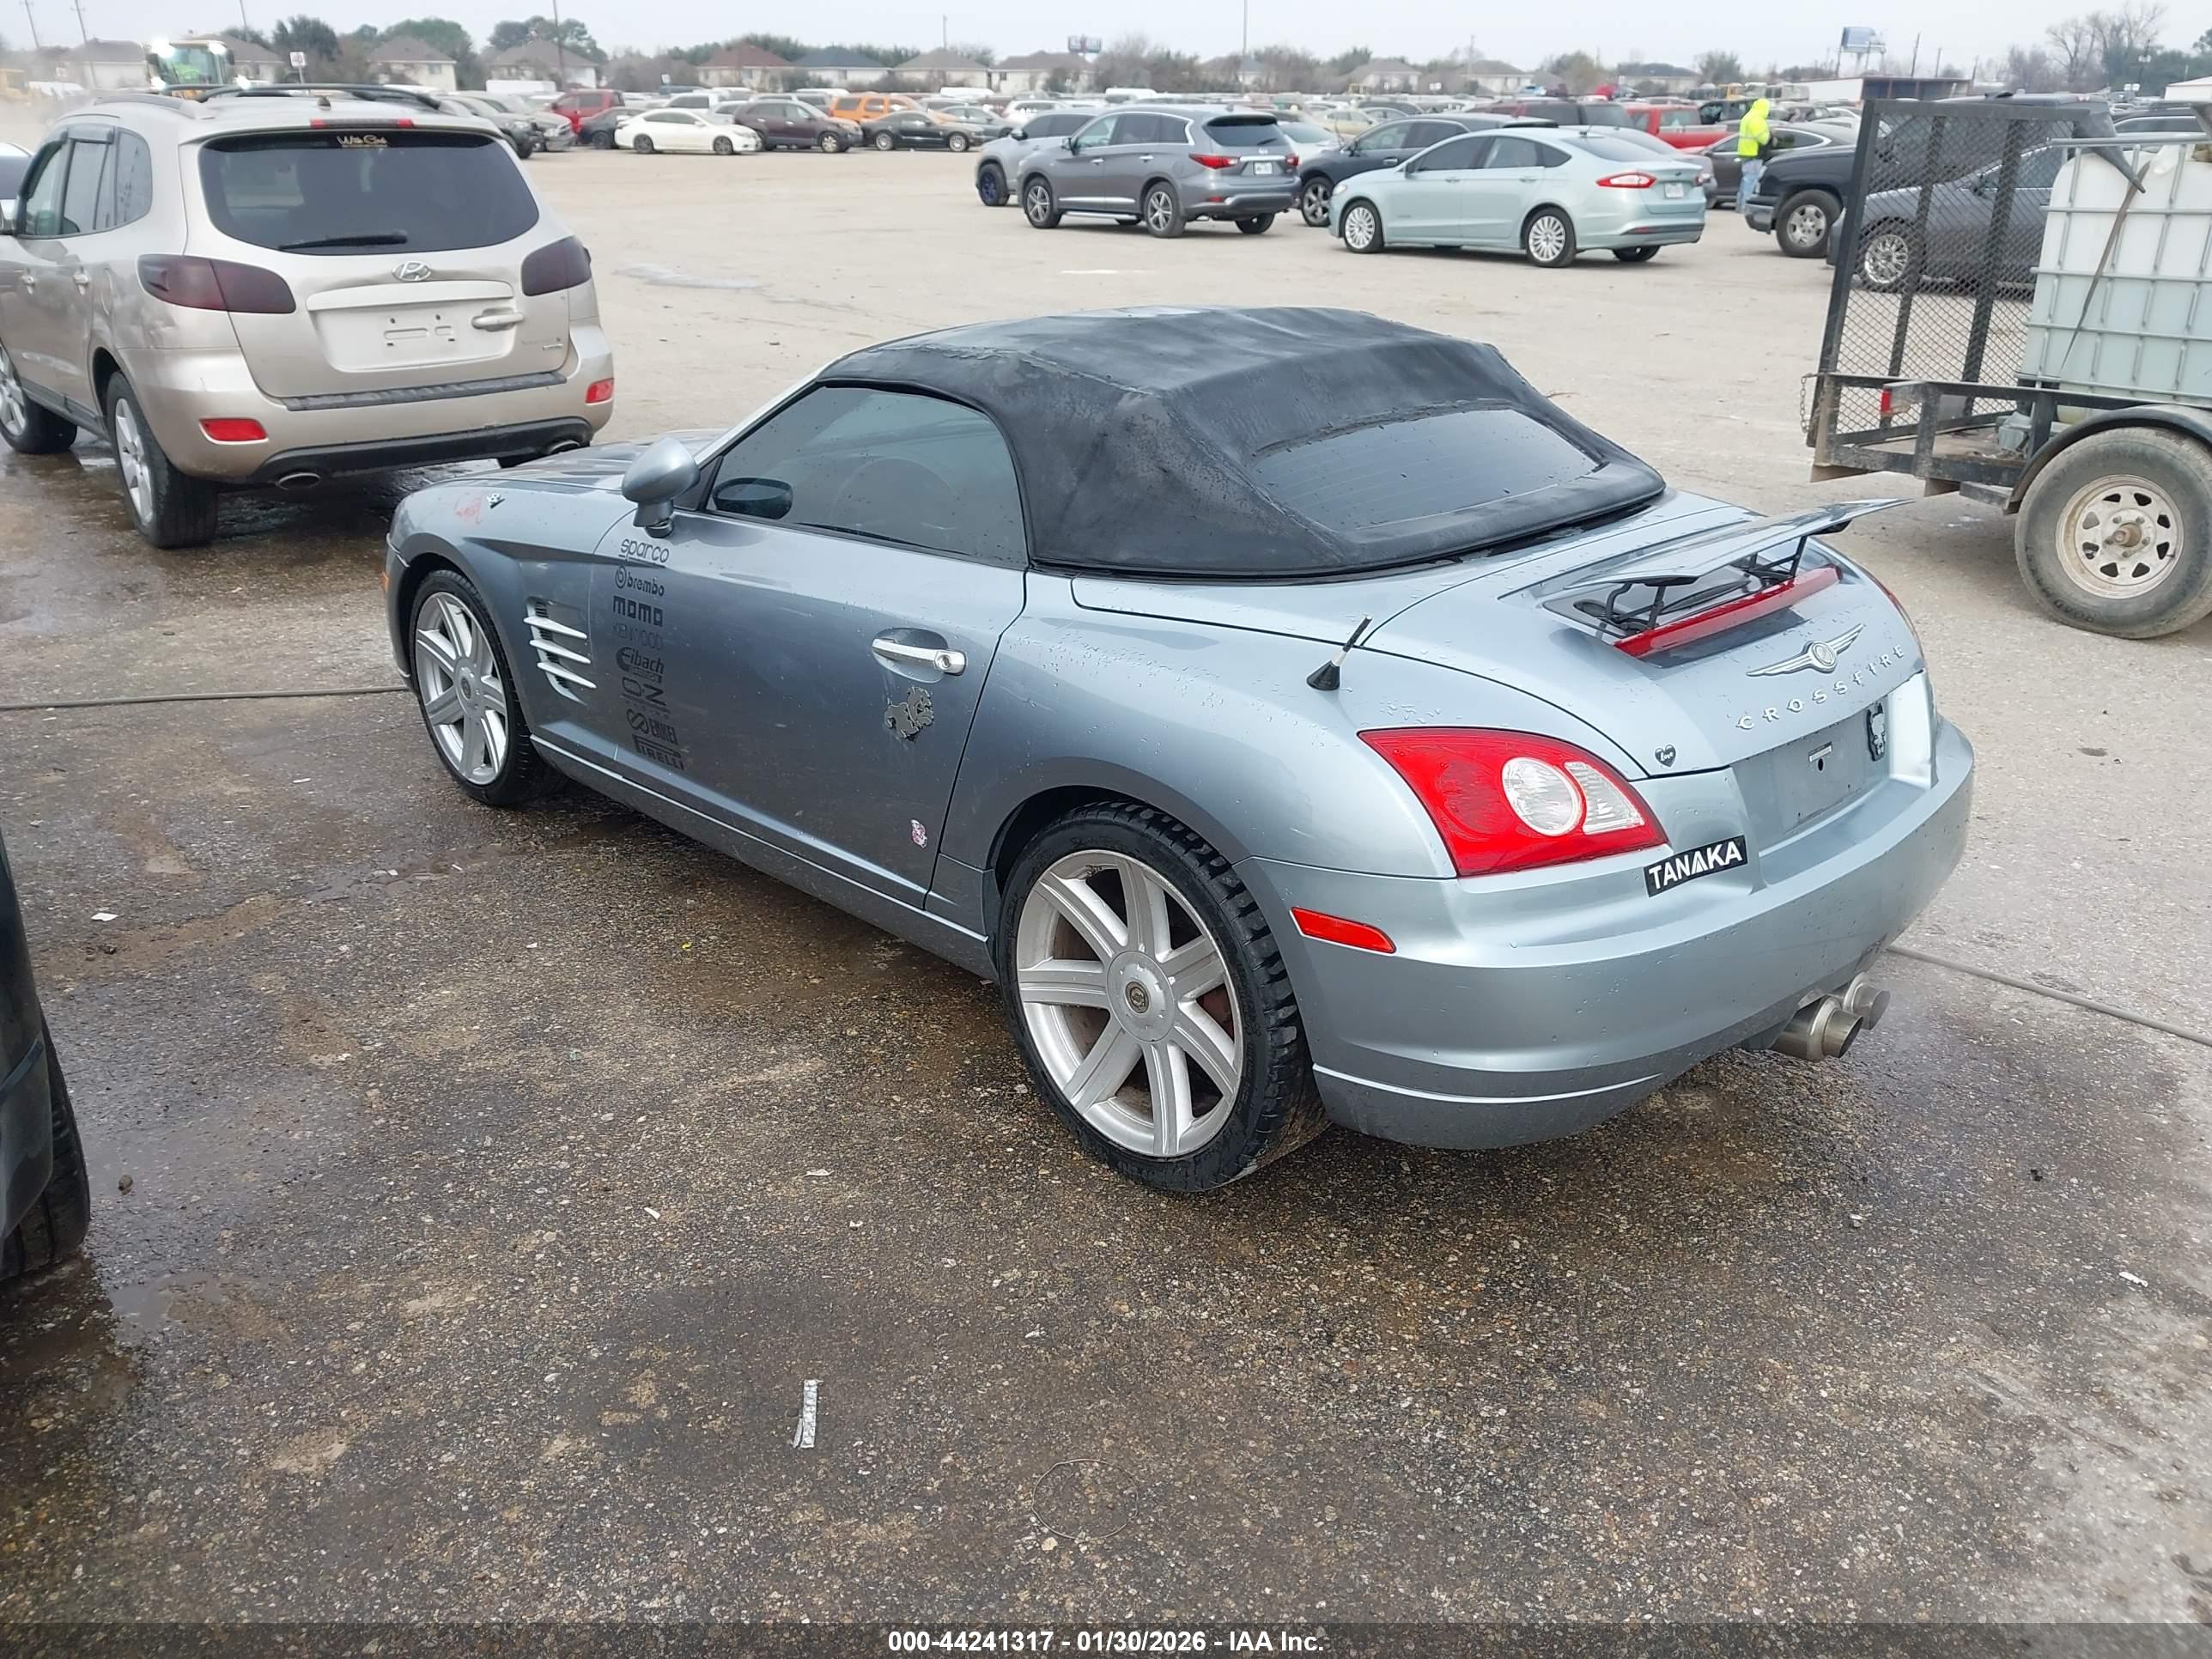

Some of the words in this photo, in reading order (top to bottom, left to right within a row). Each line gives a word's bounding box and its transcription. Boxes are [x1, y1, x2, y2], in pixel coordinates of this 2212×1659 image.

[620, 538, 670, 563] sparco
[627, 569, 665, 597] brembo
[612, 595, 664, 627] momo
[616, 646, 665, 674] Eibach
[1735, 644, 1905, 731] CROSSFIRE
[632, 733, 685, 772] PIRELLI
[1647, 840, 1744, 890] TANAKA
